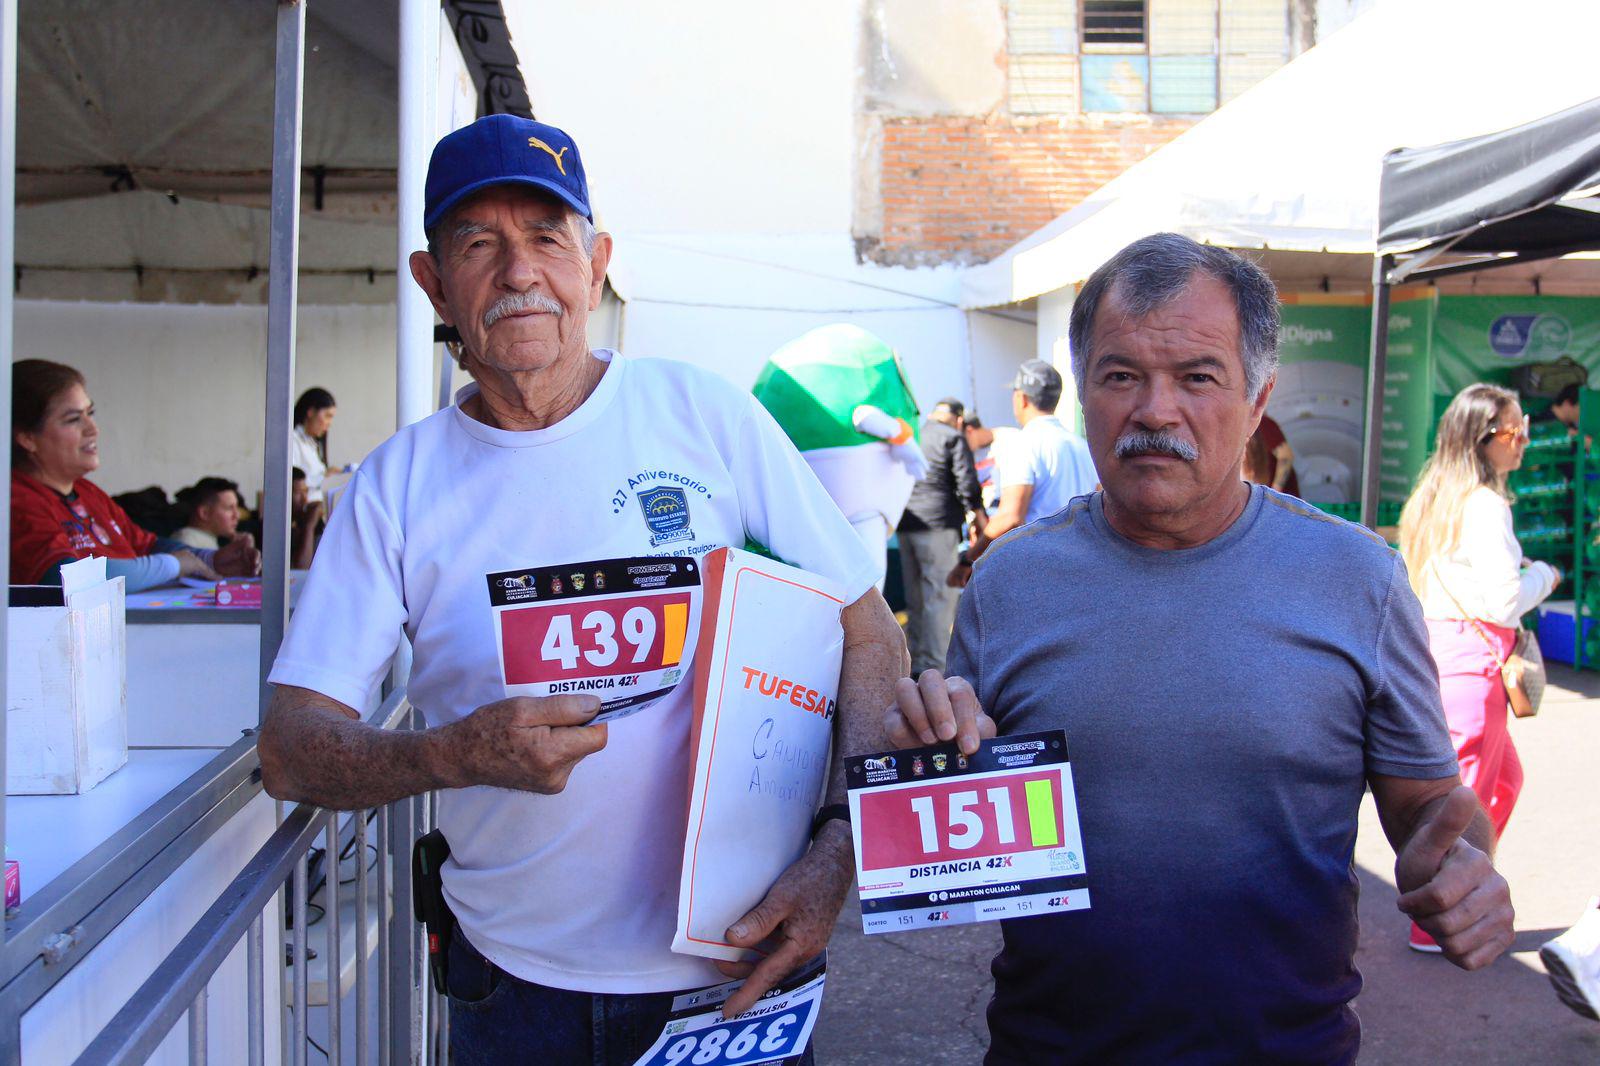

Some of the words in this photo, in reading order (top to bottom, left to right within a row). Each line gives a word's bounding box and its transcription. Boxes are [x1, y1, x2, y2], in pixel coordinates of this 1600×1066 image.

[612, 489, 628, 508] 27
[627, 469, 708, 494] Aniversario
[673, 549, 686, 558] en
[687, 543, 713, 555] Equipo
[540, 606, 657, 670] 439
[549, 681, 615, 694] DISTANCIA
[991, 740, 1045, 754] POWERADE
[911, 786, 1015, 853] 151
[909, 861, 981, 878] DISTANCIA
[949, 888, 984, 899] MARATON
[985, 884, 1020, 895] CULIACAN
[1017, 901, 1034, 911] 151
[898, 915, 914, 925] 151
[664, 1013, 797, 1066] 3986
